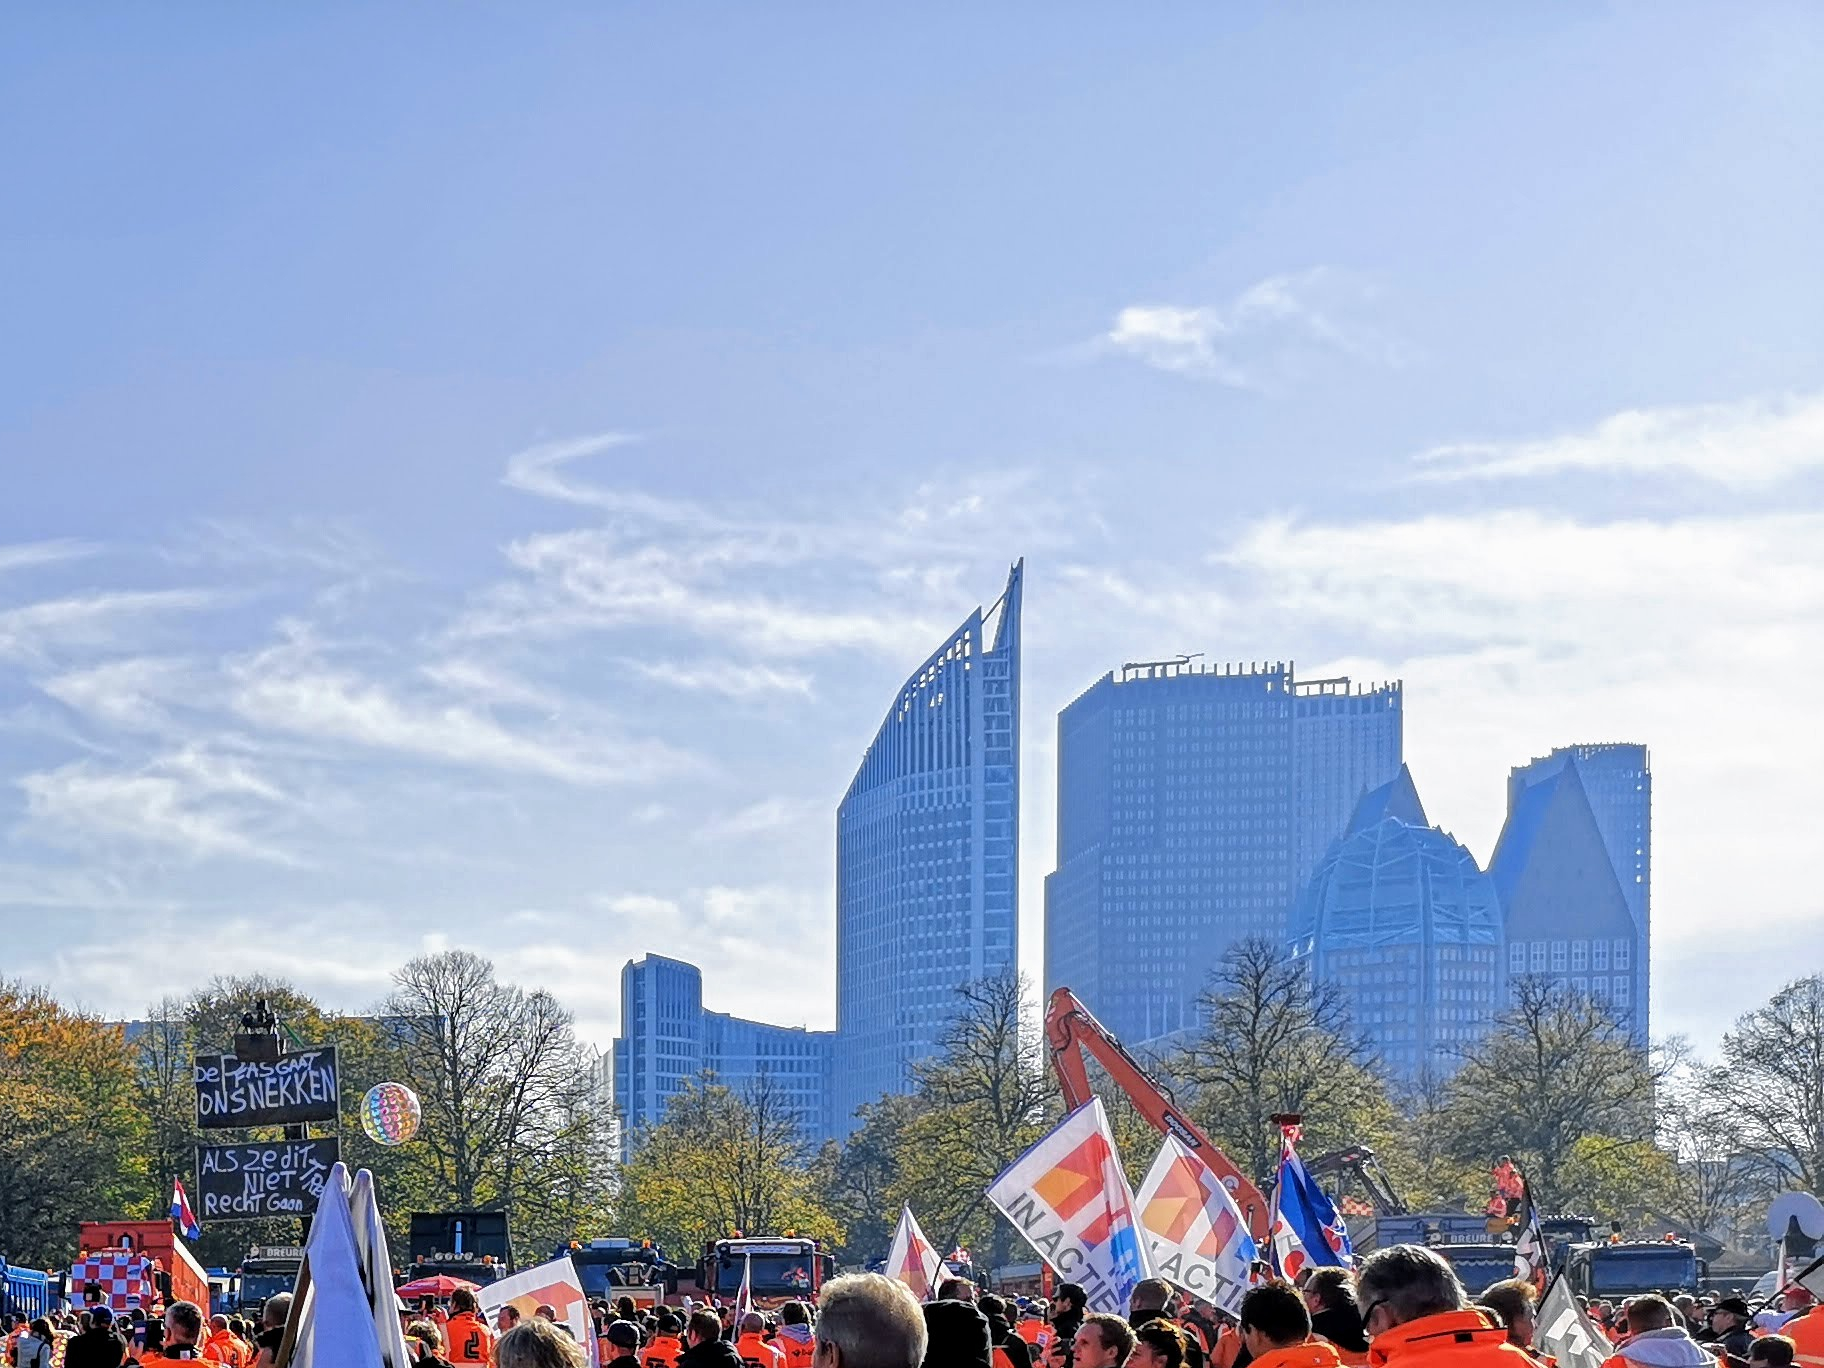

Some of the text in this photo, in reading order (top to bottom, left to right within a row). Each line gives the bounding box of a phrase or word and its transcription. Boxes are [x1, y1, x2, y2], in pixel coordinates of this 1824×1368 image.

[276, 1052, 322, 1075] GAAT
[199, 1065, 336, 1115] ONS NEKKEN
[1164, 1113, 1199, 1148] DOOSAN
[202, 1149, 239, 1175] ALS
[1006, 1192, 1119, 1313] IN ACTIE
[1450, 1234, 1493, 1244] BREURE
[1159, 1252, 1242, 1314] ACTI
